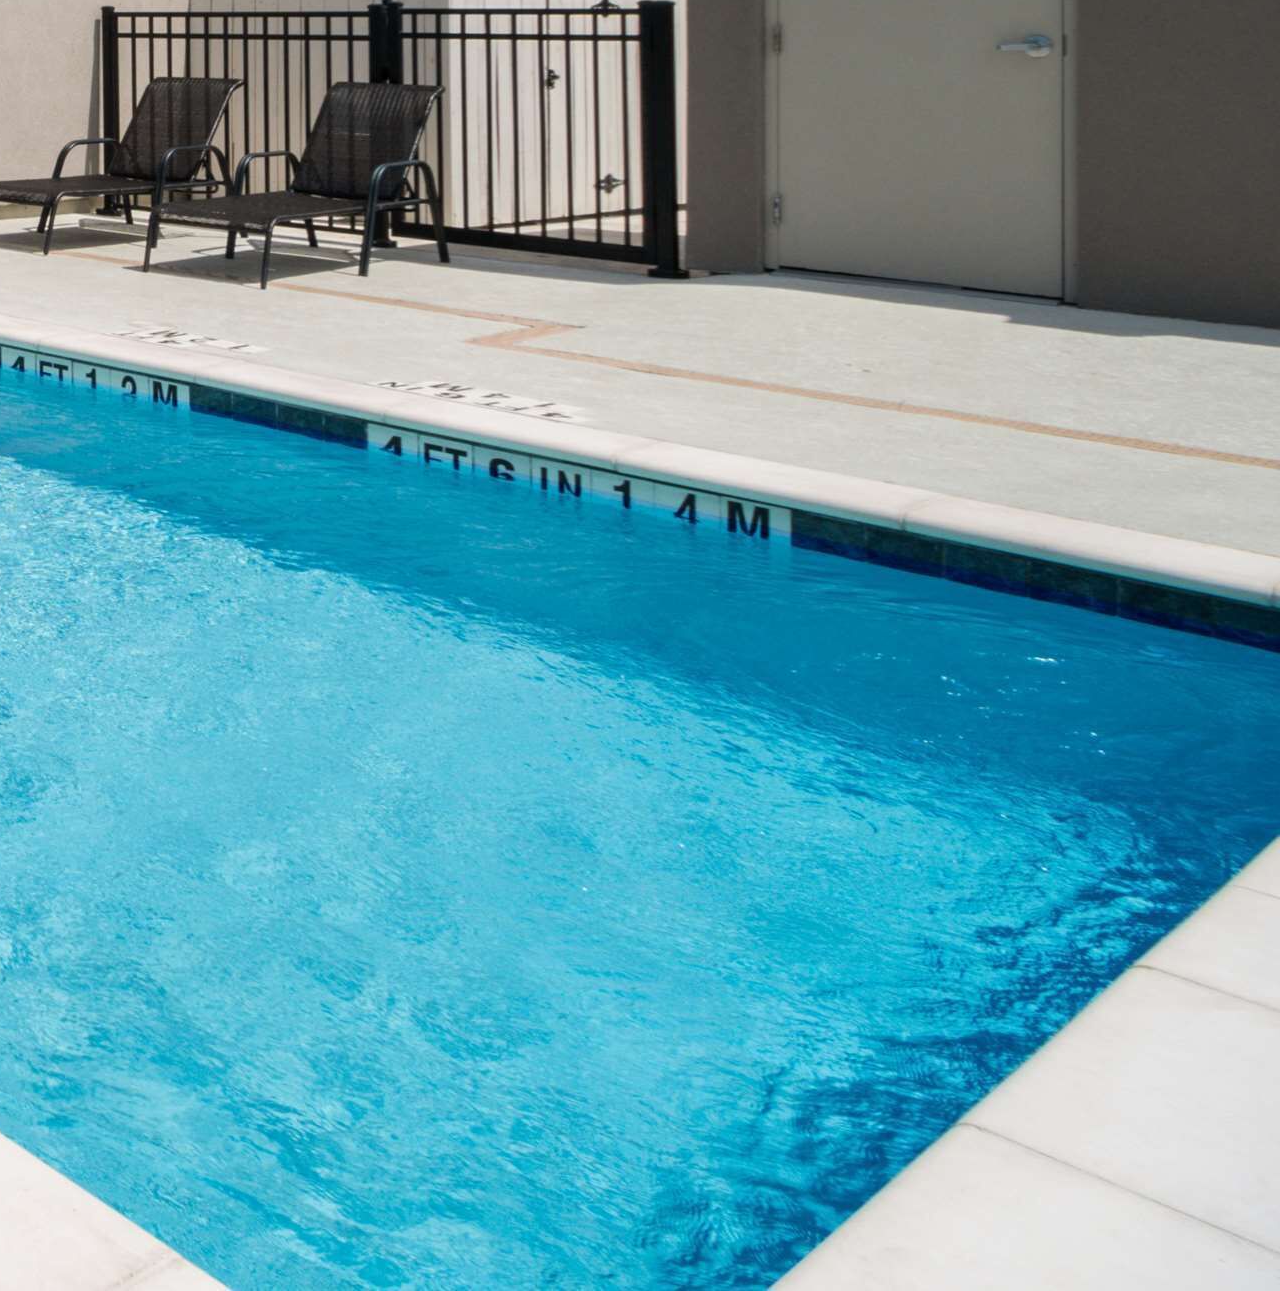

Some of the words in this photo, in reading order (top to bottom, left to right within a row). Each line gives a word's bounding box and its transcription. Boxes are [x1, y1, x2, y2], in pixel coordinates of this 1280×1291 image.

[39, 360, 69, 381] FT
[152, 381, 178, 407] M
[424, 442, 468, 471] FT
[540, 467, 582, 498] IN
[727, 501, 770, 540] M
